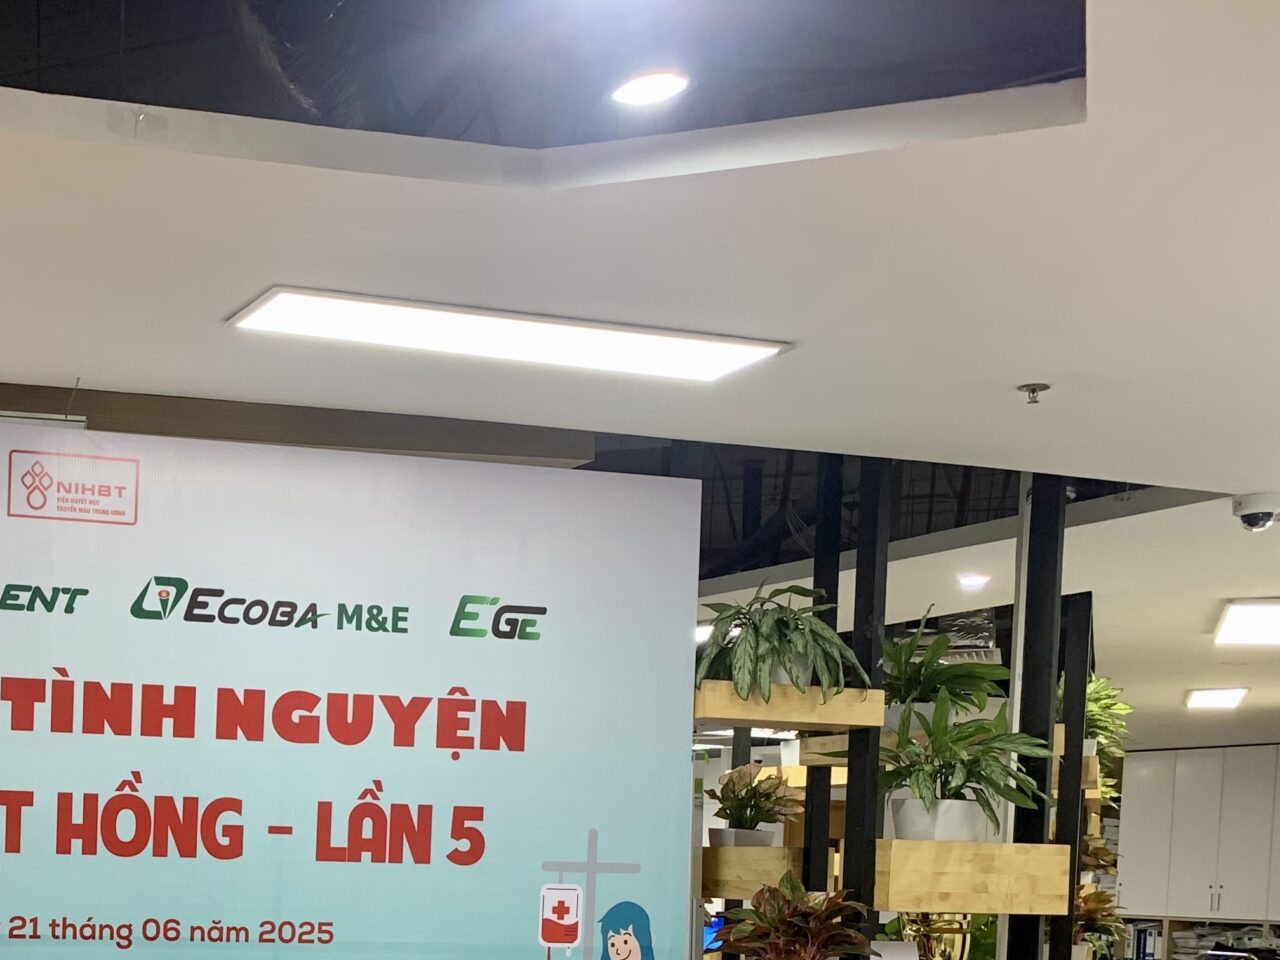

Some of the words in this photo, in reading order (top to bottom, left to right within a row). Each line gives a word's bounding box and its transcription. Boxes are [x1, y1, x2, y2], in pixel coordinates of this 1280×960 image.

[57, 481, 127, 498] NIHBT
[336, 603, 410, 634] M&E
[0, 667, 197, 739] TÌNH
[215, 686, 527, 761] NGUYỆN
[55, 770, 244, 861] HỒNG
[315, 779, 434, 865] LẦN
[445, 805, 486, 866] 5
[7, 915, 42, 940] 21
[49, 916, 133, 950] tháng
[141, 918, 181, 942] 06
[189, 919, 250, 944] năm
[258, 920, 335, 945] 2025
